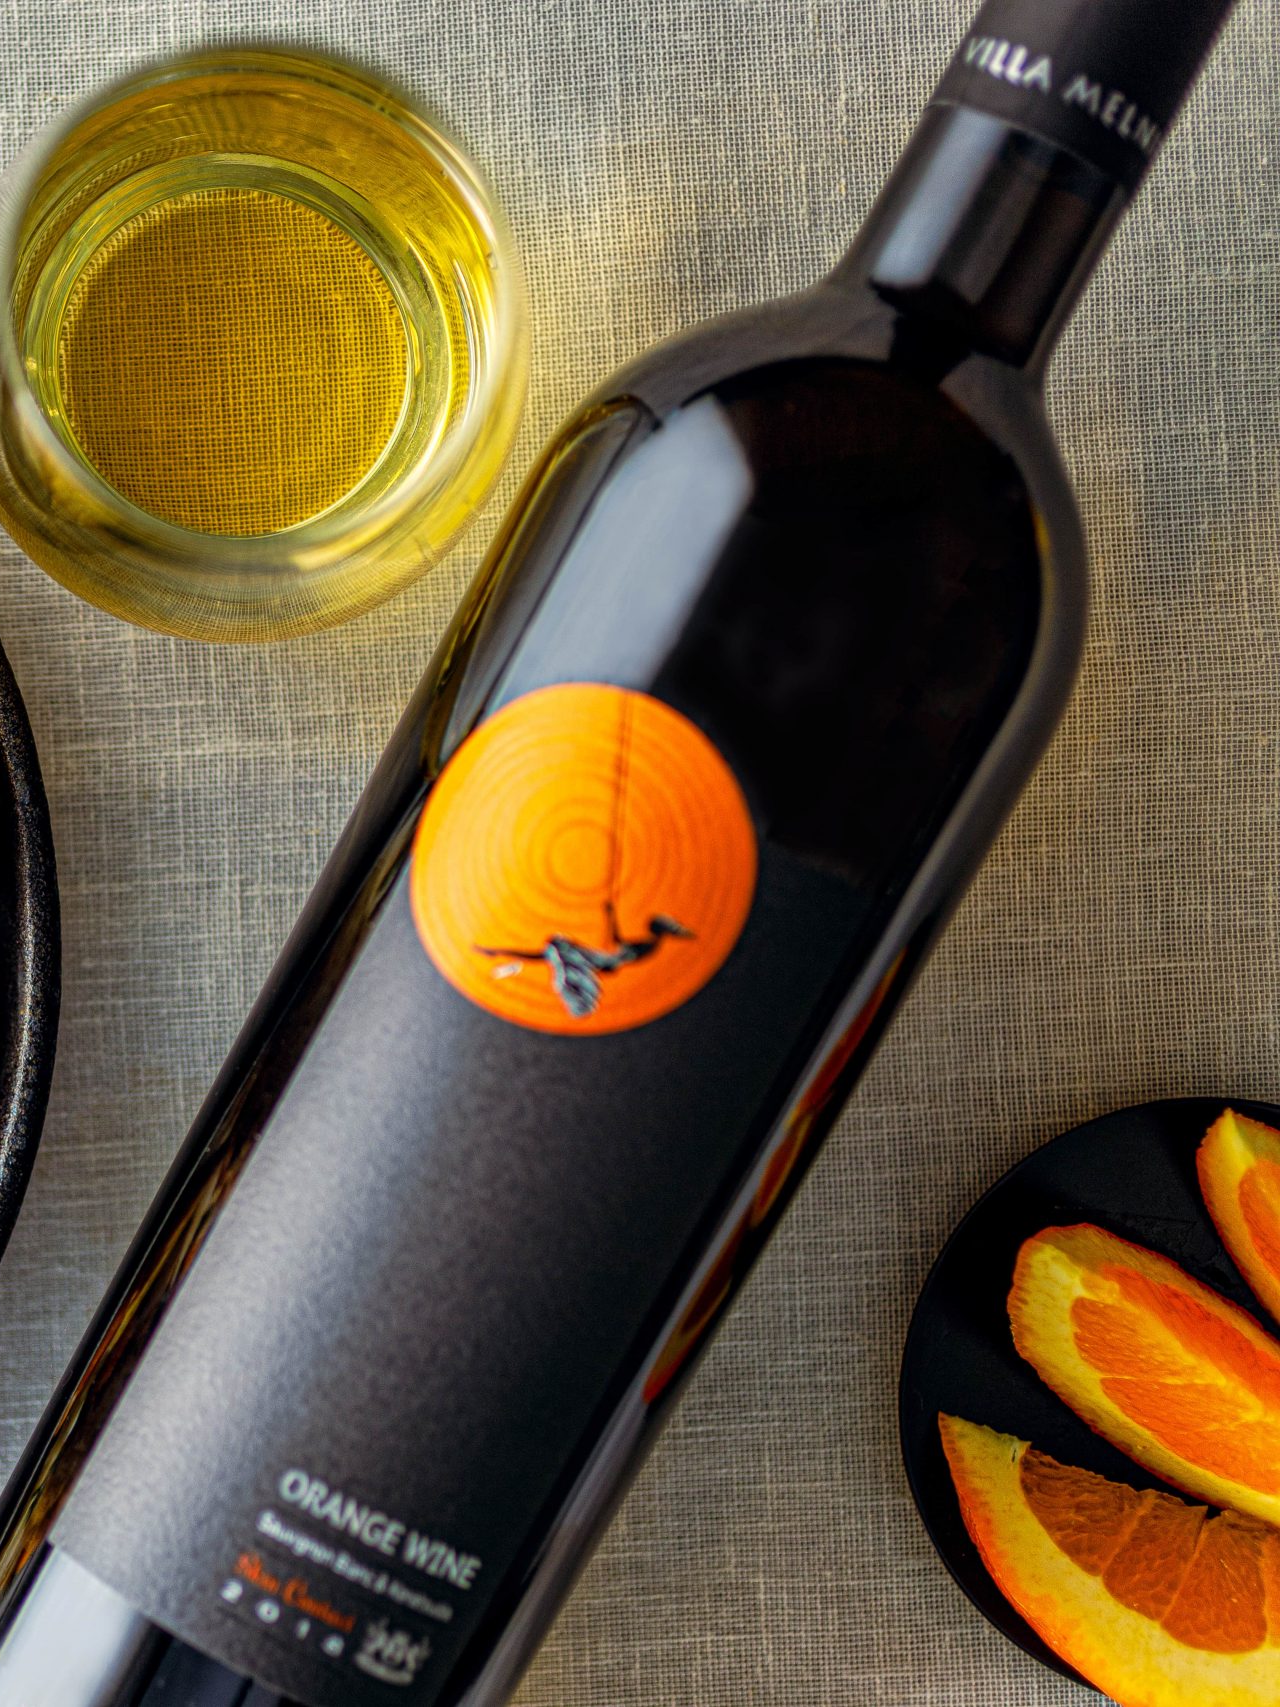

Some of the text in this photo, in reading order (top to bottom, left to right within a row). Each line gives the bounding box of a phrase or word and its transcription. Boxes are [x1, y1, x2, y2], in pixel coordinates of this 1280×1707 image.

[965, 37, 1052, 94] VILLA
[278, 1468, 482, 1589] ORANGE WINE
